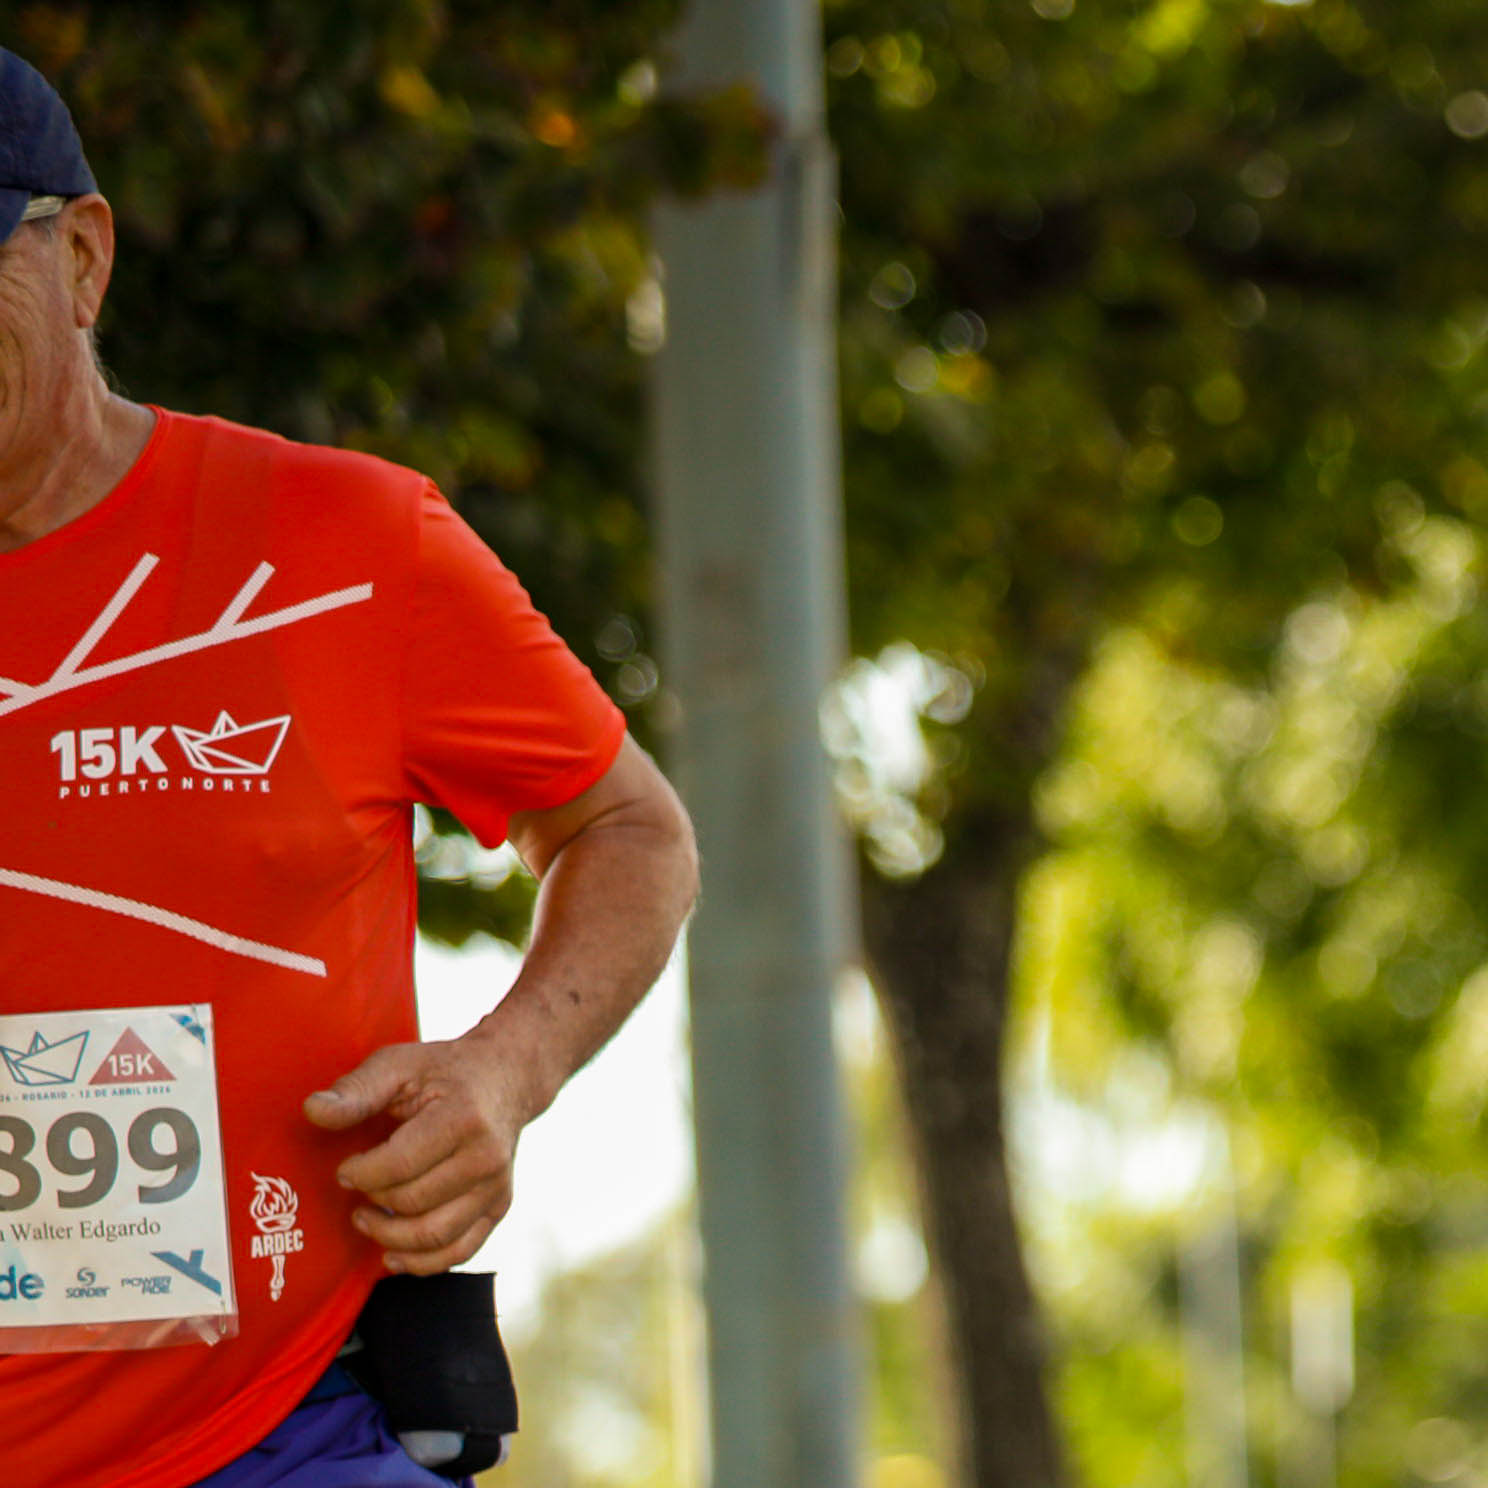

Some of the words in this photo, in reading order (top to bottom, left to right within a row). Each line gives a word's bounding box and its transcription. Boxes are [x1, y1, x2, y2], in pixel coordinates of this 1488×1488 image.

[51, 726, 168, 780] 15K
[60, 778, 169, 799] PUERTO
[182, 777, 270, 793] NORTE
[108, 1053, 154, 1076] 15K
[22, 1091, 67, 1102] ROSARIO
[95, 1087, 107, 1097] DE
[11, 1222, 73, 1241] Walter
[80, 1216, 161, 1241] Edgardo
[251, 1229, 304, 1258] ARDEC
